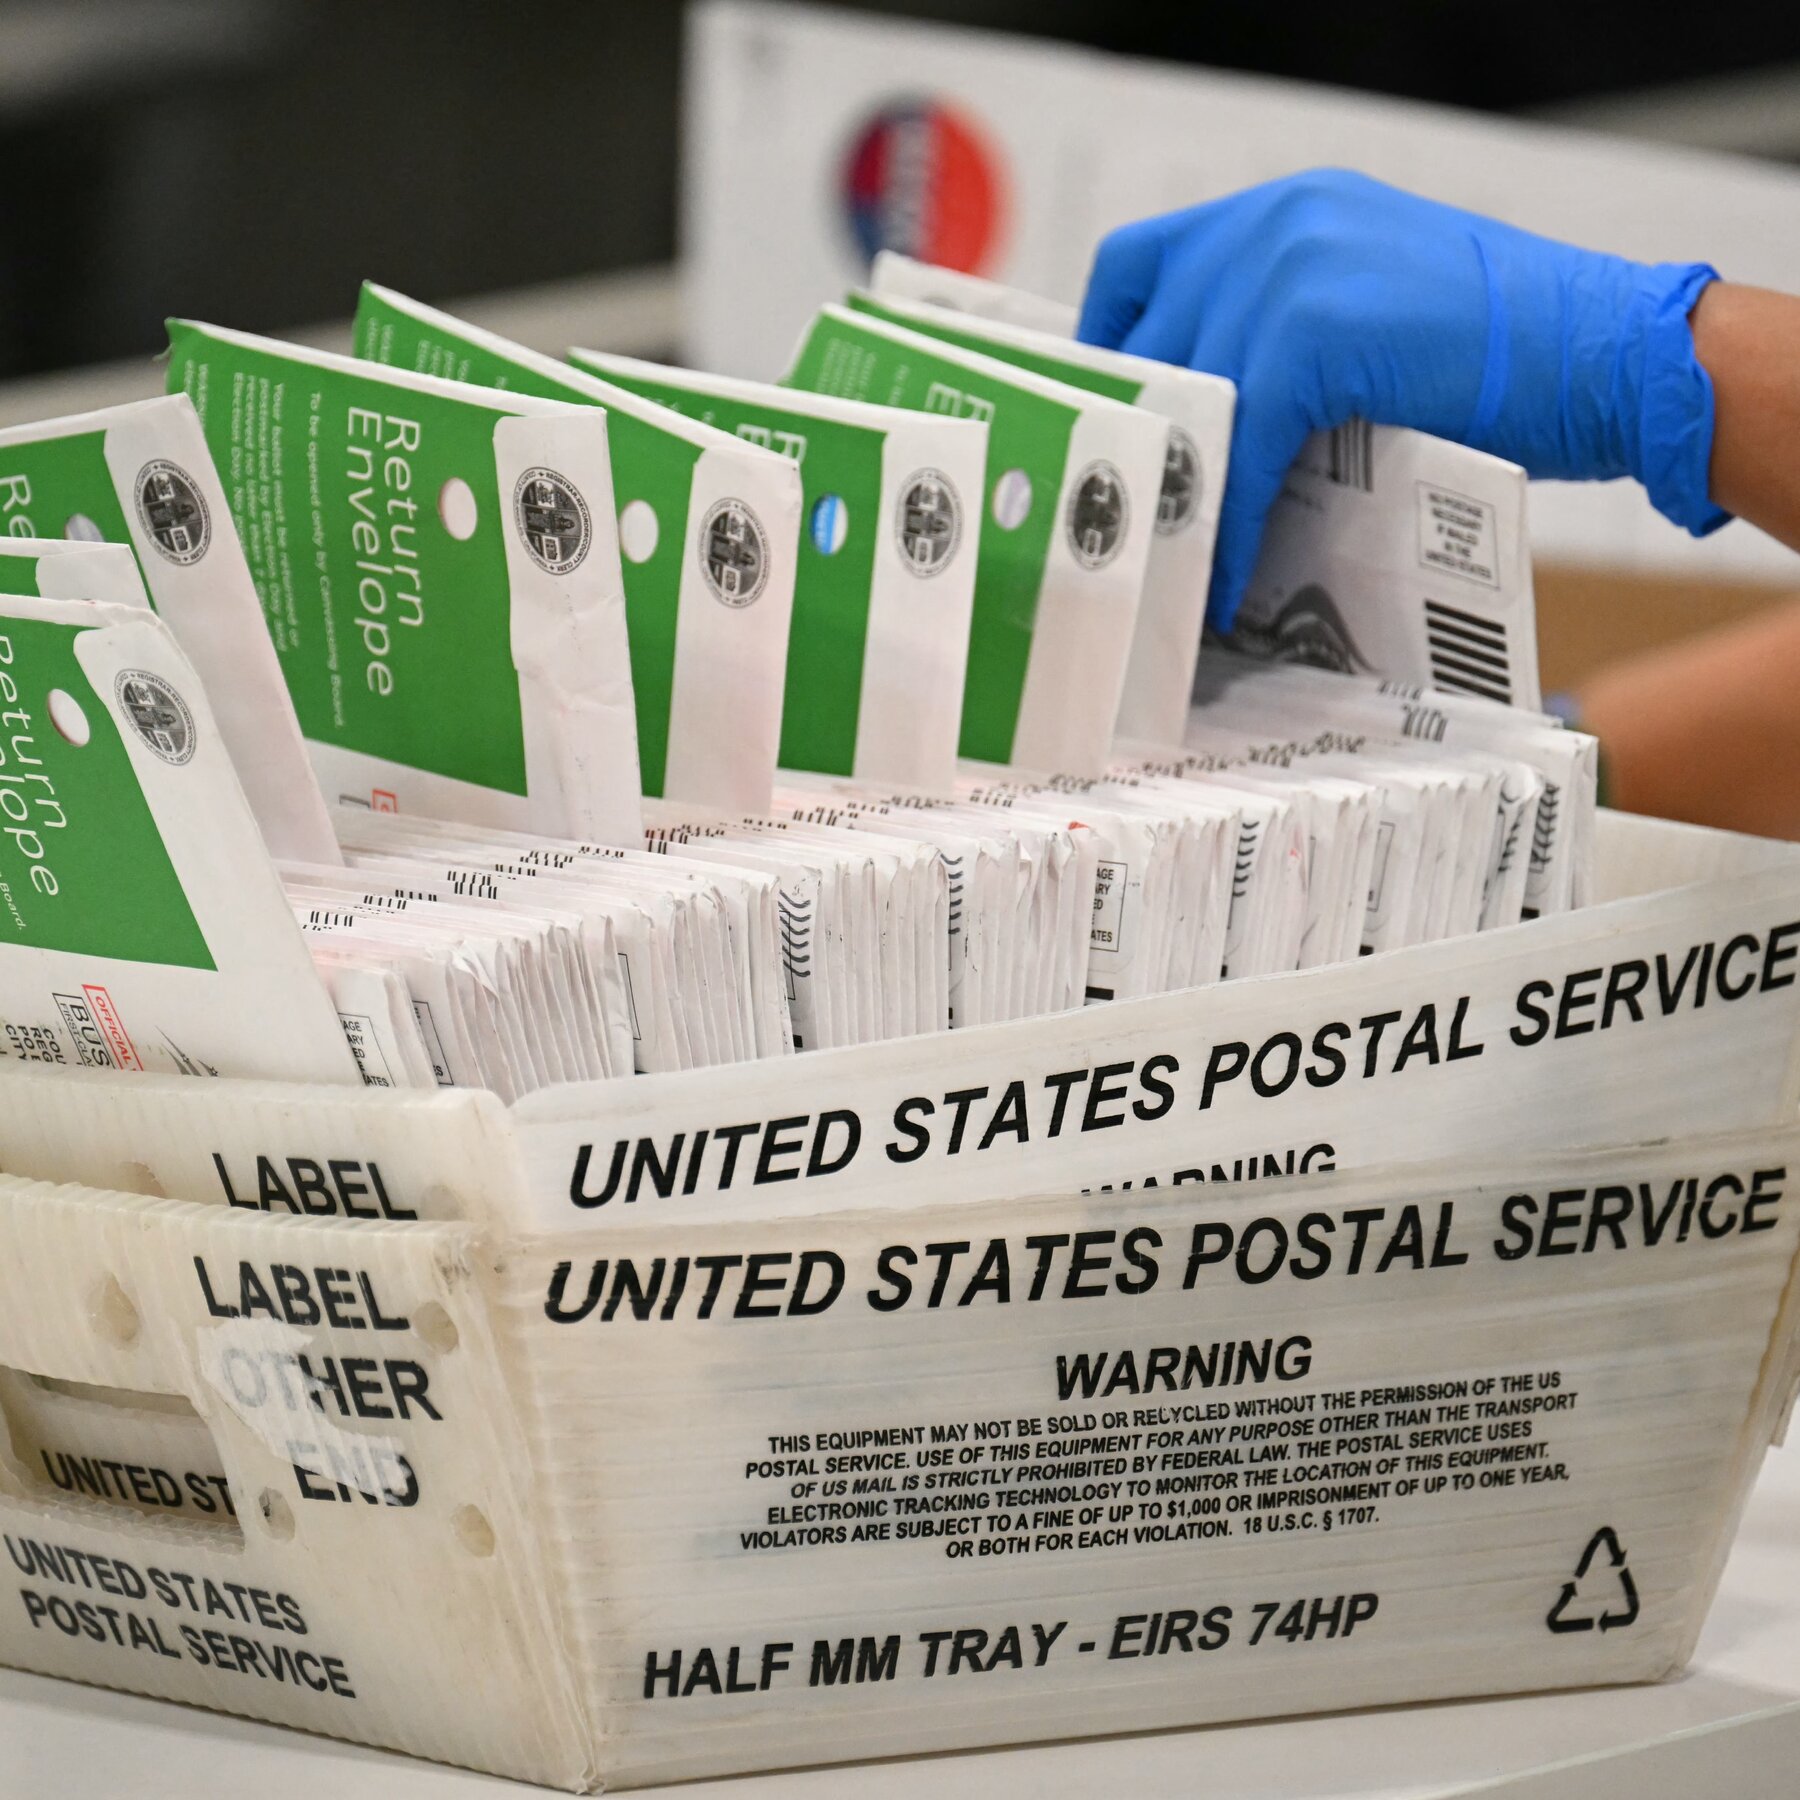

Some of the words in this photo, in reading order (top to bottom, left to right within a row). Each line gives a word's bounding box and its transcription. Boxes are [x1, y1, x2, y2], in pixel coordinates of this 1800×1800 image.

[306, 441, 320, 506] opened
[311, 510, 325, 547] only
[346, 405, 395, 697] Envelope
[383, 414, 425, 628] Return
[315, 551, 328, 573] by
[320, 575, 339, 671] Canvassing
[95, 996, 132, 1064] OFFICIAL
[570, 1110, 861, 1208] UNITED
[886, 1055, 1179, 1163] STATES
[1199, 997, 1484, 1110] POSTAL
[1510, 922, 1800, 1046] SERVICE
[212, 1153, 418, 1220] LABEL
[545, 1251, 845, 1323] UNITED
[867, 1227, 1162, 1312] STATES
[1183, 1202, 1468, 1289] POSTAL
[1494, 1168, 1786, 1260] SERVICE
[194, 1256, 410, 1330] LABEL
[221, 1346, 443, 1421] OTHER
[1055, 1336, 1312, 1401] WARNING
[746, 1459, 819, 1479] POSTAL
[825, 1452, 910, 1474] SERVICE.
[917, 1449, 954, 1468] USE
[959, 1447, 985, 1464] OF
[990, 1443, 1030, 1462] THIS
[1035, 1434, 1142, 1458] EQUIPMENT
[1146, 1431, 1184, 1449] FOR
[1187, 1427, 1226, 1446] ANY
[1229, 1419, 1314, 1442] PURPOSE
[1319, 1413, 1379, 1434] OTHER
[1385, 1408, 1431, 1427] THAN
[1436, 1404, 1470, 1423] THE
[1475, 1393, 1578, 1418] TRANSPORT
[768, 1435, 810, 1454] THIS
[816, 1427, 925, 1451] EQUIPMENT
[931, 1424, 968, 1443] MAY
[974, 1420, 1011, 1440] NOT
[1017, 1418, 1042, 1437] BE
[1047, 1414, 1097, 1434] SOLD
[1102, 1412, 1128, 1429] OR
[1133, 1403, 1230, 1427] RECYCLED
[1234, 1395, 1316, 1418] WITHOUT
[1321, 1391, 1356, 1410] THE
[1360, 1381, 1467, 1407] PERMISSION
[1472, 1378, 1496, 1396] OF
[1500, 1374, 1533, 1393] THE
[1538, 1371, 1560, 1389] US
[40, 1449, 186, 1509] UNITED
[286, 1440, 420, 1507] END
[768, 1499, 888, 1525] ELECTRONIC
[893, 1492, 990, 1515] TRACKING
[995, 1482, 1122, 1508] TECHNOLOGY
[1127, 1480, 1151, 1497] TO
[1155, 1472, 1238, 1495] MONITOR
[1243, 1469, 1278, 1487] THE
[1282, 1460, 1371, 1484] LOCATION
[1375, 1457, 1400, 1475] OF
[1405, 1453, 1443, 1472] THIS
[1447, 1442, 1549, 1468] EQUIPMENT.
[791, 1482, 818, 1498] OF
[822, 1480, 848, 1497] US
[852, 1477, 897, 1494] MAIL
[902, 1475, 920, 1491] IS
[925, 1467, 1013, 1489] STRICTLY
[1016, 1458, 1127, 1482] PROHIBITED
[1132, 1455, 1158, 1473] BY
[1161, 1448, 1244, 1471] FEDERAL
[1249, 1444, 1290, 1463] LAW.
[1297, 1440, 1331, 1459] THE
[1336, 1434, 1404, 1455] POSTAL
[1409, 1425, 1482, 1449] SERVICE
[1488, 1420, 1532, 1441] USES
[740, 1526, 847, 1550] VIOLATORS
[851, 1523, 890, 1542] ARE
[896, 1516, 982, 1539] SUBJECT
[987, 1514, 1011, 1532] TO
[1015, 1513, 1028, 1530] A
[1033, 1509, 1074, 1529] FINE
[1079, 1507, 1104, 1525] OF
[1109, 1505, 1133, 1523] UP
[1138, 1502, 1162, 1520] TO
[1167, 1497, 1221, 1519] $1,000
[1226, 1494, 1252, 1512] OR
[1257, 1481, 1391, 1510] IMPRISONMENT
[1395, 1479, 1419, 1496] OF
[1424, 1476, 1447, 1493] UP
[1452, 1473, 1475, 1491] TO
[1479, 1469, 1516, 1488] ONE
[1520, 1463, 1569, 1484] YEAR,
[945, 1541, 973, 1558] OR
[978, 1536, 1030, 1556] BOTH
[1035, 1533, 1073, 1552] FOR
[1078, 1528, 1128, 1548] EACH
[1133, 1520, 1232, 1543] VIOLATION.
[1244, 1517, 1262, 1534] 18
[1267, 1512, 1317, 1532] U.S.C.
[1338, 1506, 1379, 1525] 1707.
[4, 1535, 146, 1599] UNITED
[150, 1568, 308, 1635] STATES
[21, 1590, 181, 1659] POSTAL
[180, 1625, 356, 1698] SERVICE
[644, 1643, 793, 1699] HALF
[809, 1635, 900, 1686] MM
[919, 1622, 1067, 1677] TRAY
[1108, 1606, 1232, 1659] EIRS
[1249, 1593, 1378, 1645] 74HP
